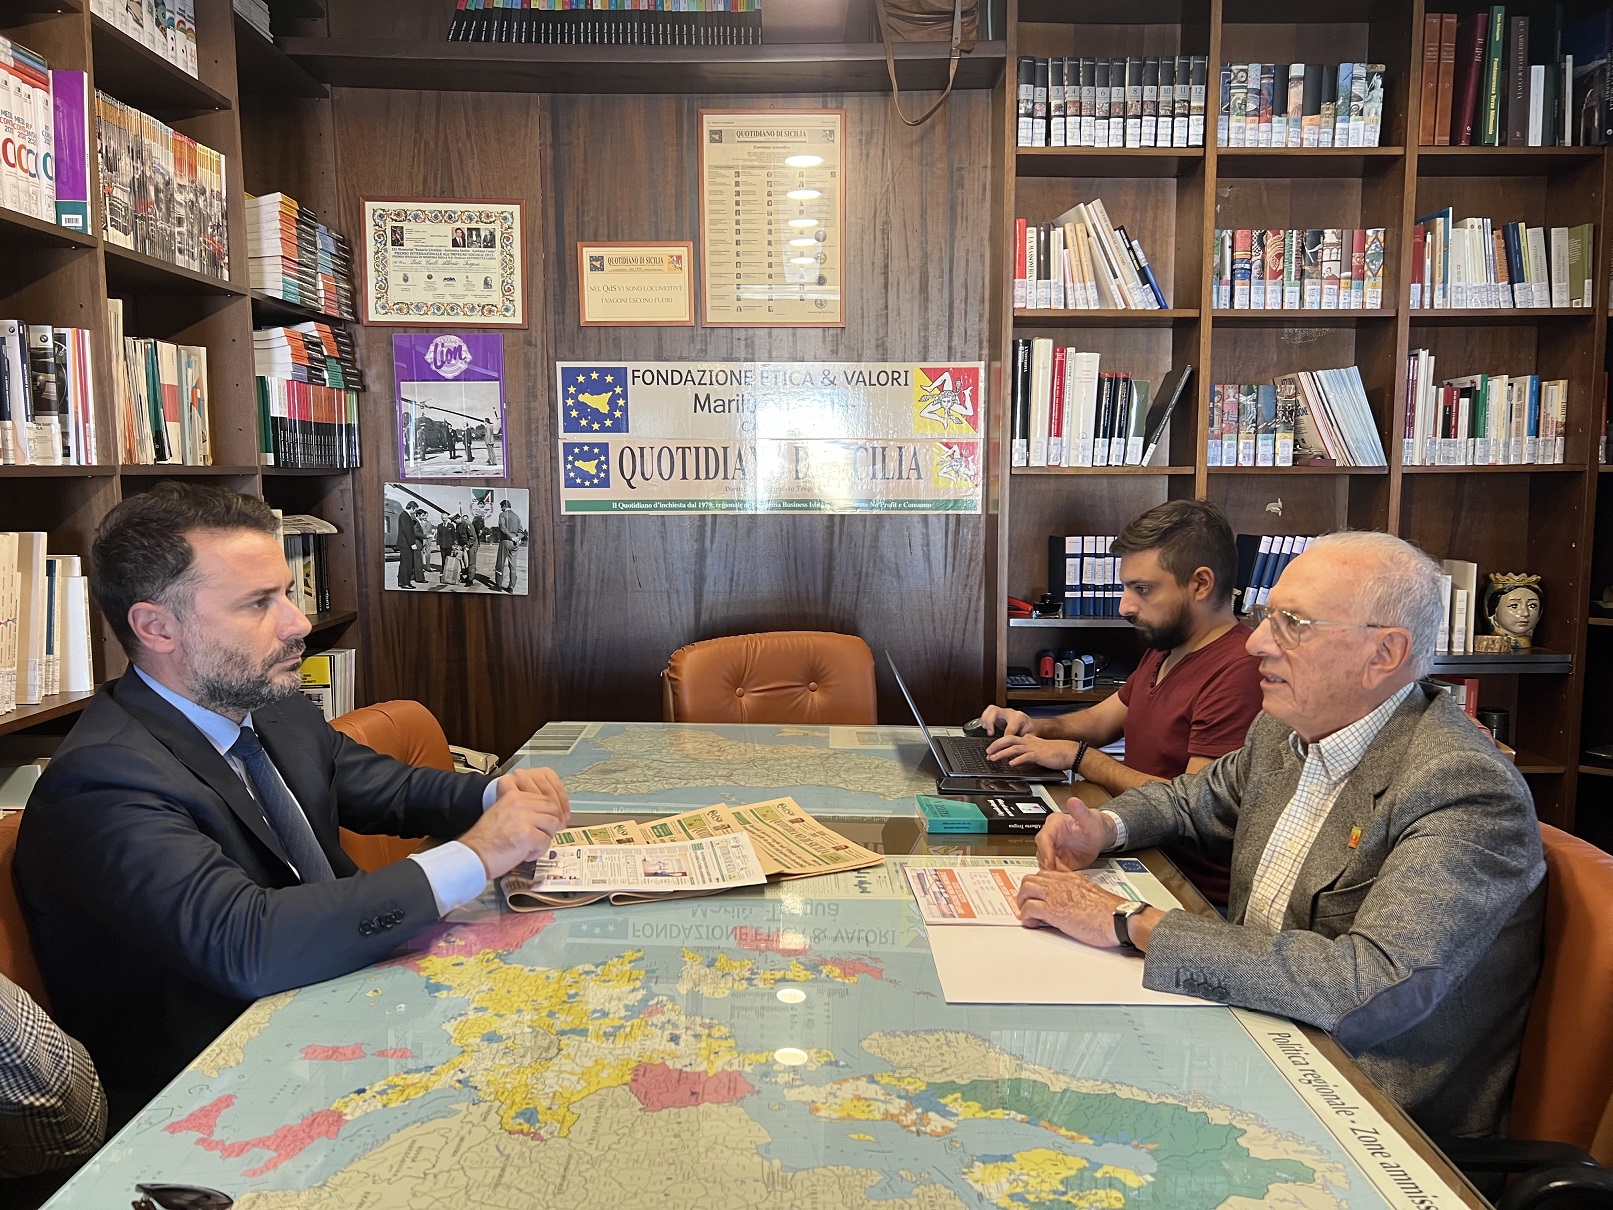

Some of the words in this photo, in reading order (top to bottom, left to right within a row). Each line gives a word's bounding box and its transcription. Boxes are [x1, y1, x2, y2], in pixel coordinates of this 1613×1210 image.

[736, 130, 775, 139] QUOTIDIANO
[776, 130, 783, 138] DI
[784, 130, 807, 138] SICILIA
[608, 256, 638, 266] QUOTIDIANO
[646, 256, 664, 264] SICILIA
[602, 285, 616, 293] QdS
[631, 370, 753, 386] FONDAZIONE
[760, 370, 814, 386] ETICA
[821, 370, 837, 386] &
[844, 370, 910, 386] VALORI
[715, 502, 738, 510] regionale
[1267, 1032, 1310, 1066] Politica
[1298, 1069, 1359, 1116] regionale
[1350, 1127, 1391, 1158] Zone
